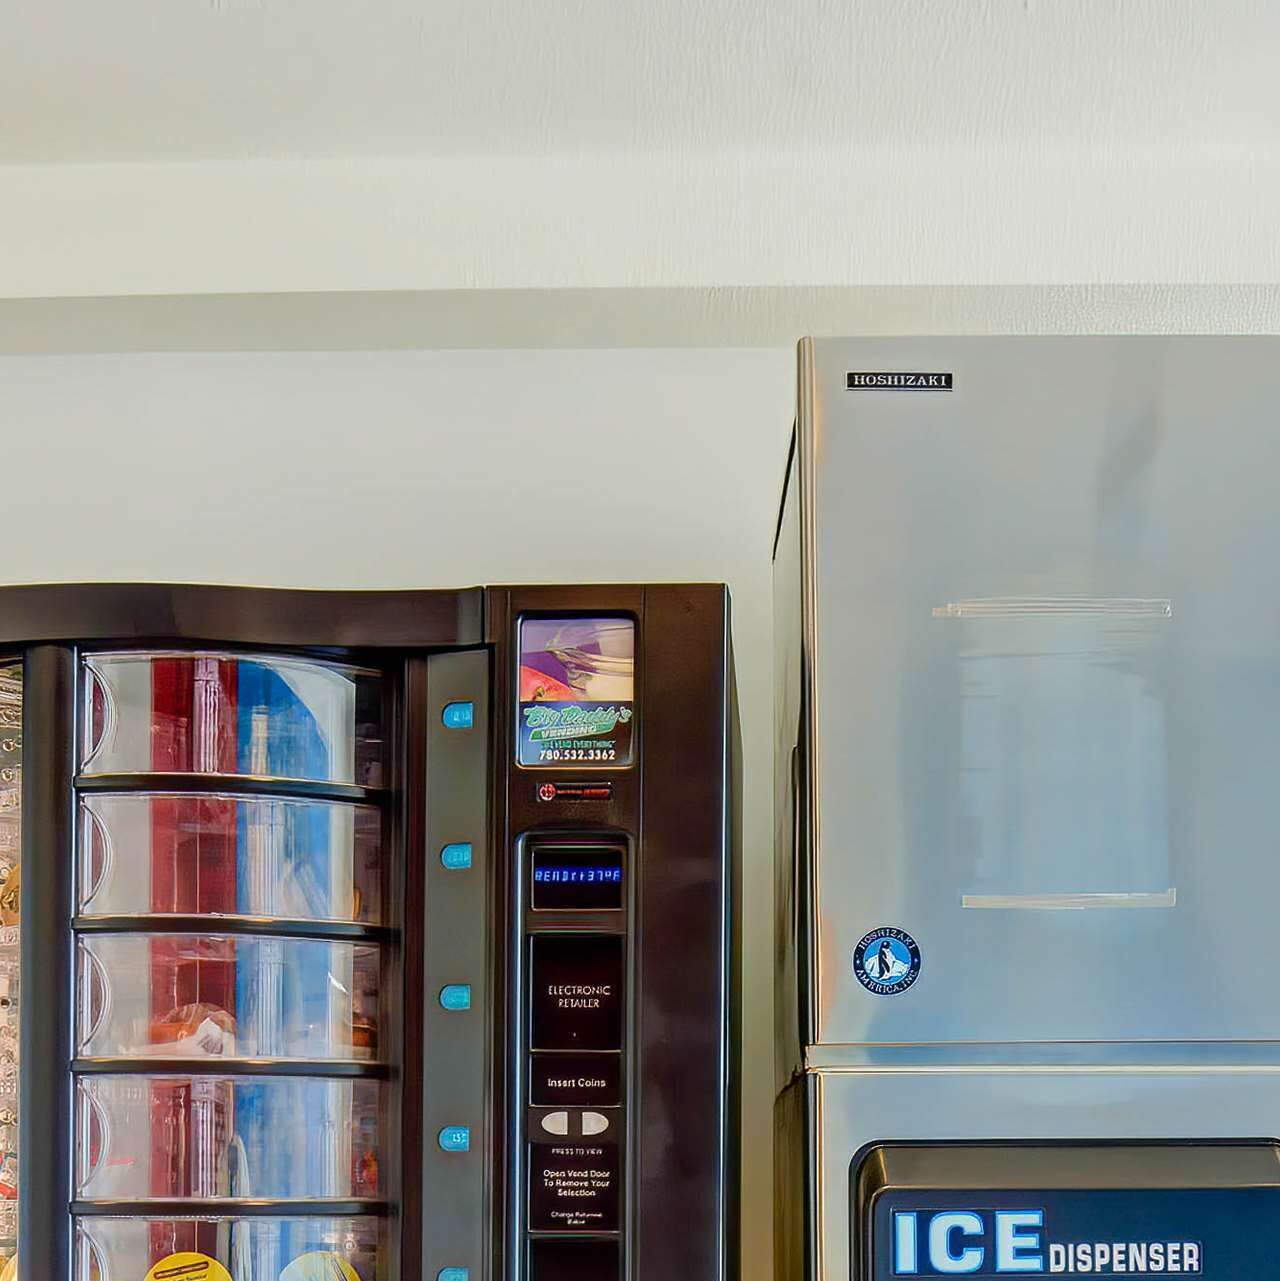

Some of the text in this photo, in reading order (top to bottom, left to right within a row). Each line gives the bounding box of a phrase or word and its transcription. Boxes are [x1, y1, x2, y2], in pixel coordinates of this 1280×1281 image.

[854, 374, 946, 386] HOSHIZAKI
[524, 705, 561, 727] Big
[541, 724, 597, 739] VENDING
[540, 750, 615, 760] 780.532.3362
[859, 929, 916, 950] HOSHIZAKI
[548, 985, 611, 995] ELECTRONIC
[558, 999, 600, 1008] RETAILER
[548, 1078, 606, 1088] Insert Coins
[543, 1169, 610, 1178] Open Vend Door
[544, 1179, 610, 1187] To Remove Your
[557, 1188, 596, 1197] Selection
[895, 1210, 1200, 1274] ICE DISPENSER
